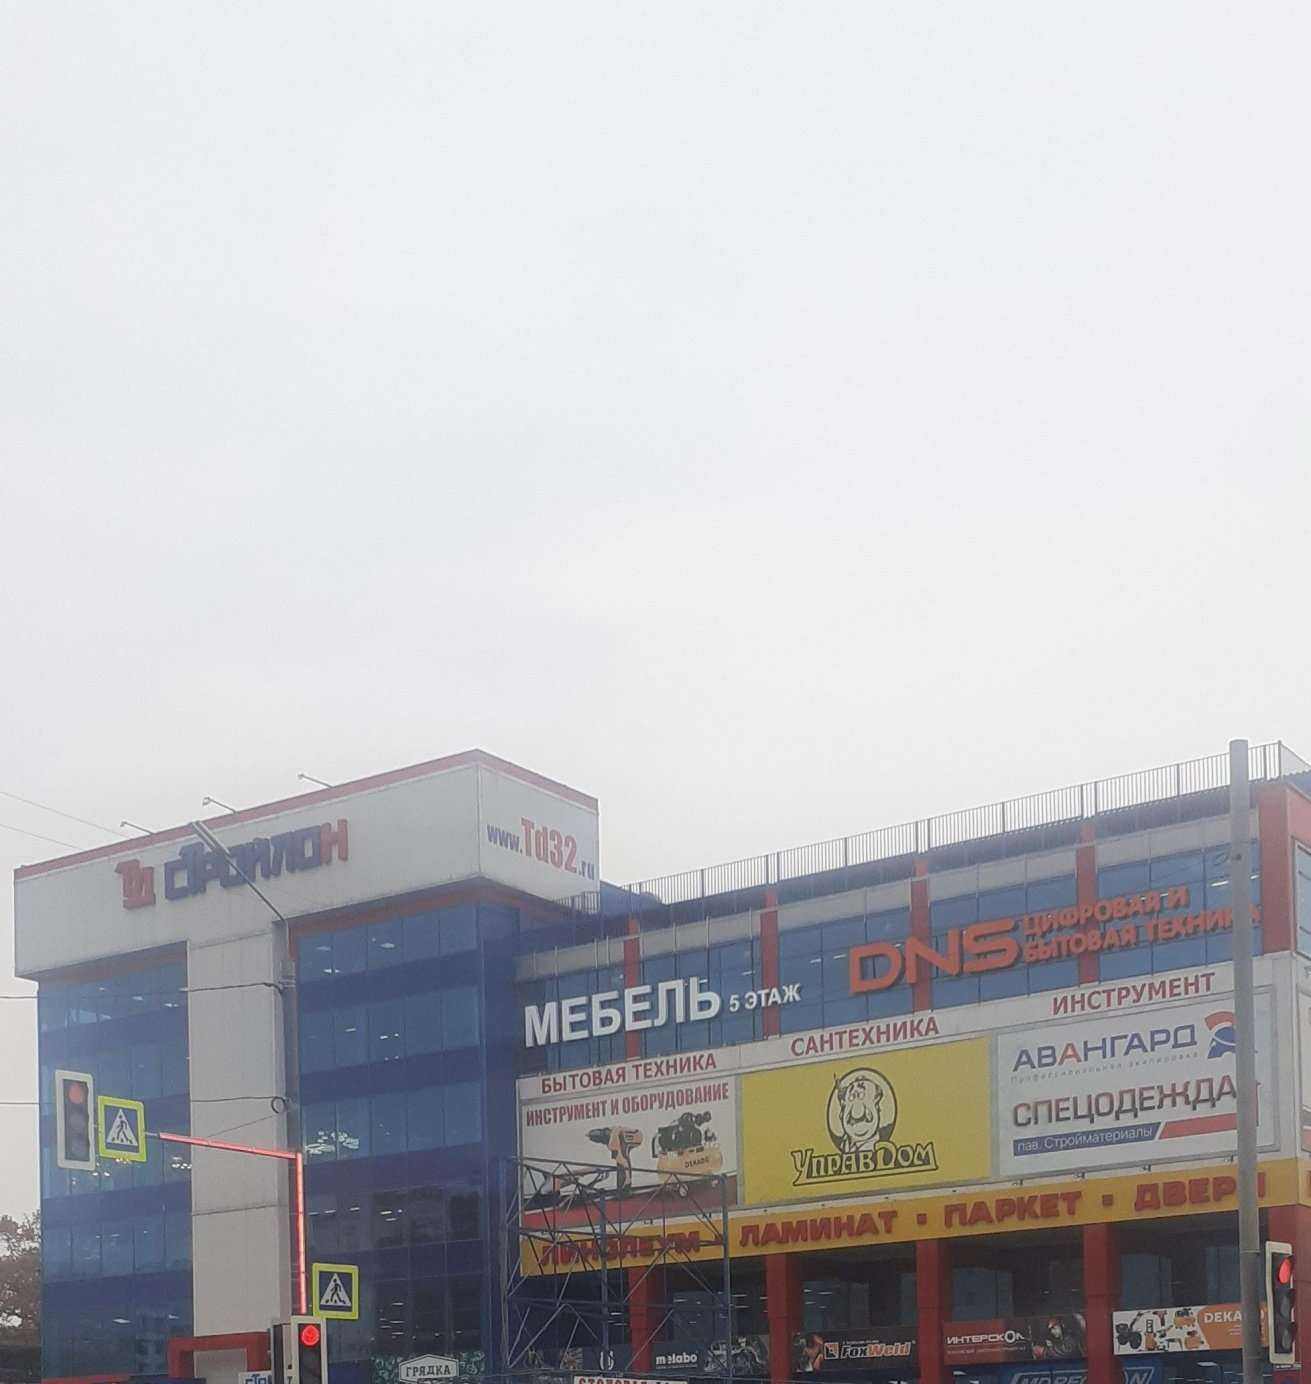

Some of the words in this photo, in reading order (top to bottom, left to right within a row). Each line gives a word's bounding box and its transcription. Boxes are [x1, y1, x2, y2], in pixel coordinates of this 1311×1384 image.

[486, 817, 595, 880] www.Td32.ru
[1023, 892, 1161, 936] ЦИФРОВАЯ
[1167, 885, 1190, 910] И
[849, 918, 1019, 996] DNS
[1023, 925, 1138, 964] БЫТОВАЯ
[524, 976, 721, 1049] МЕБЕЛЬ
[729, 994, 740, 1013] 5
[744, 983, 802, 1010] ЭТАЖ
[1052, 972, 1215, 1015] ИНСТРУМЕНТ
[790, 1016, 939, 1057] САНТЕХНИКА
[1013, 1024, 1197, 1072] АВАНГАРД
[541, 1066, 627, 1095] БЫТОВАЯ
[632, 1053, 717, 1081] ТЕХНИКА
[526, 1099, 608, 1127] ИНСТРУМЕНТ
[610, 1098, 620, 1115] И
[622, 1082, 729, 1114] ОБОРУДОВАНИЕ
[1013, 1074, 1237, 1127] СПЕЦОДЕЖДА
[1044, 1127, 1153, 1150] Стройматериалы
[739, 1211, 898, 1248] ЛАМИНАТ
[944, 1191, 1082, 1228] ПАРКЕТ
[406, 1365, 451, 1378] ГРЯДКА
